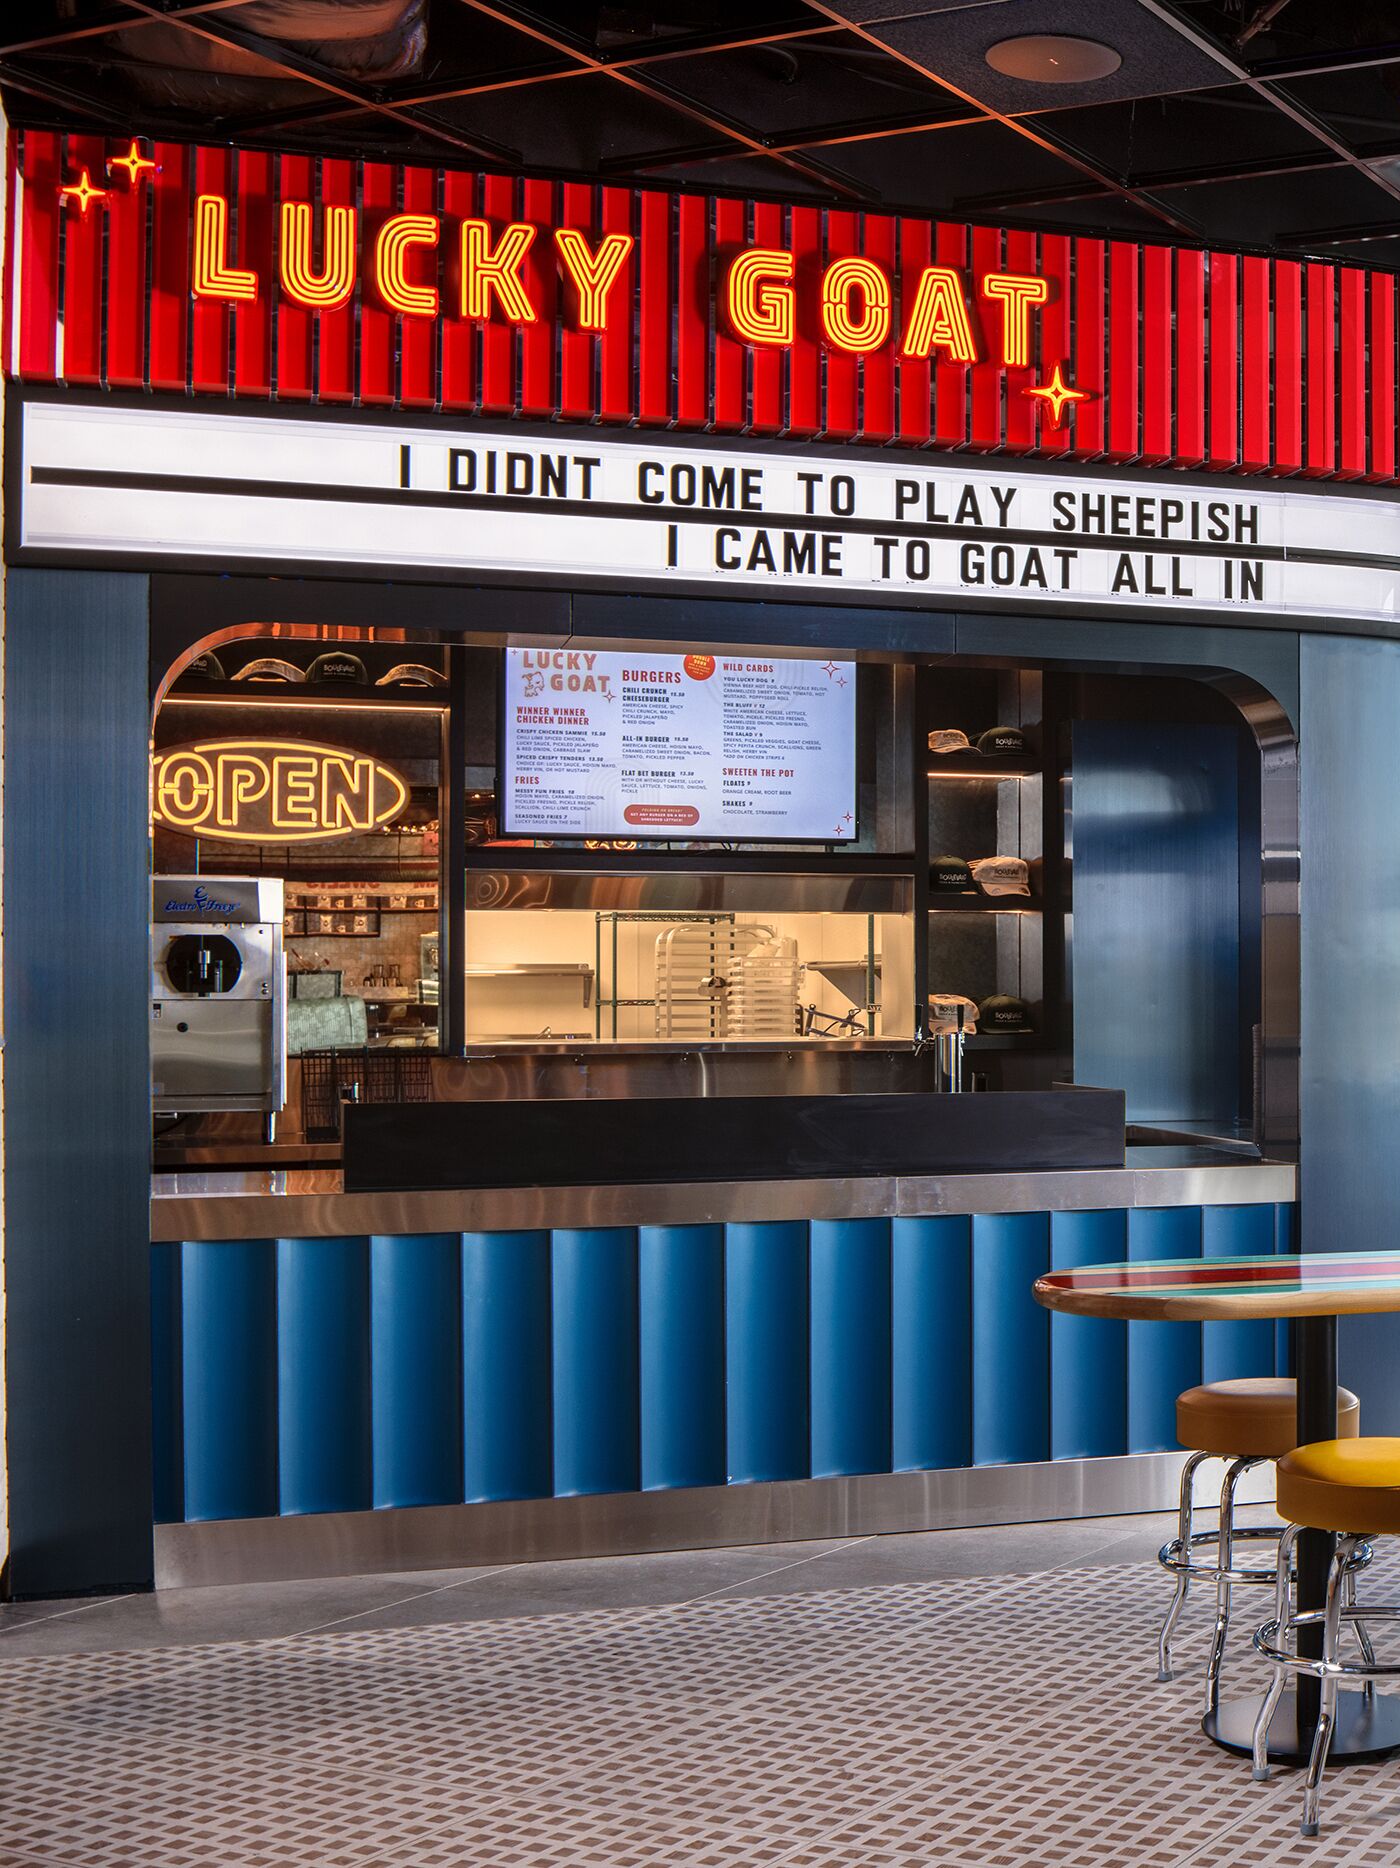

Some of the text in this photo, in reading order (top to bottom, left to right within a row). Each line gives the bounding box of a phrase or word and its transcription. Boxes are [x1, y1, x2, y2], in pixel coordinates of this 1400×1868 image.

[191, 194, 1048, 370] LUCKY GOAT
[400, 445, 1259, 544] I DIDNT COME TO PLAY SHEEPISH
[668, 524, 1264, 601] I CAME TO GOAT ALL IN
[523, 651, 597, 670] LUCKY
[550, 674, 610, 692] GOAT
[623, 670, 681, 683] BURGERS
[517, 706, 585, 716] WINNER WINNER
[517, 716, 589, 725] CHICKEN DINNER
[515, 776, 539, 784] FRIES
[723, 768, 794, 777] SWEETEN THE POT
[158, 752, 374, 829] OPEN
[164, 901, 196, 912] Electro
